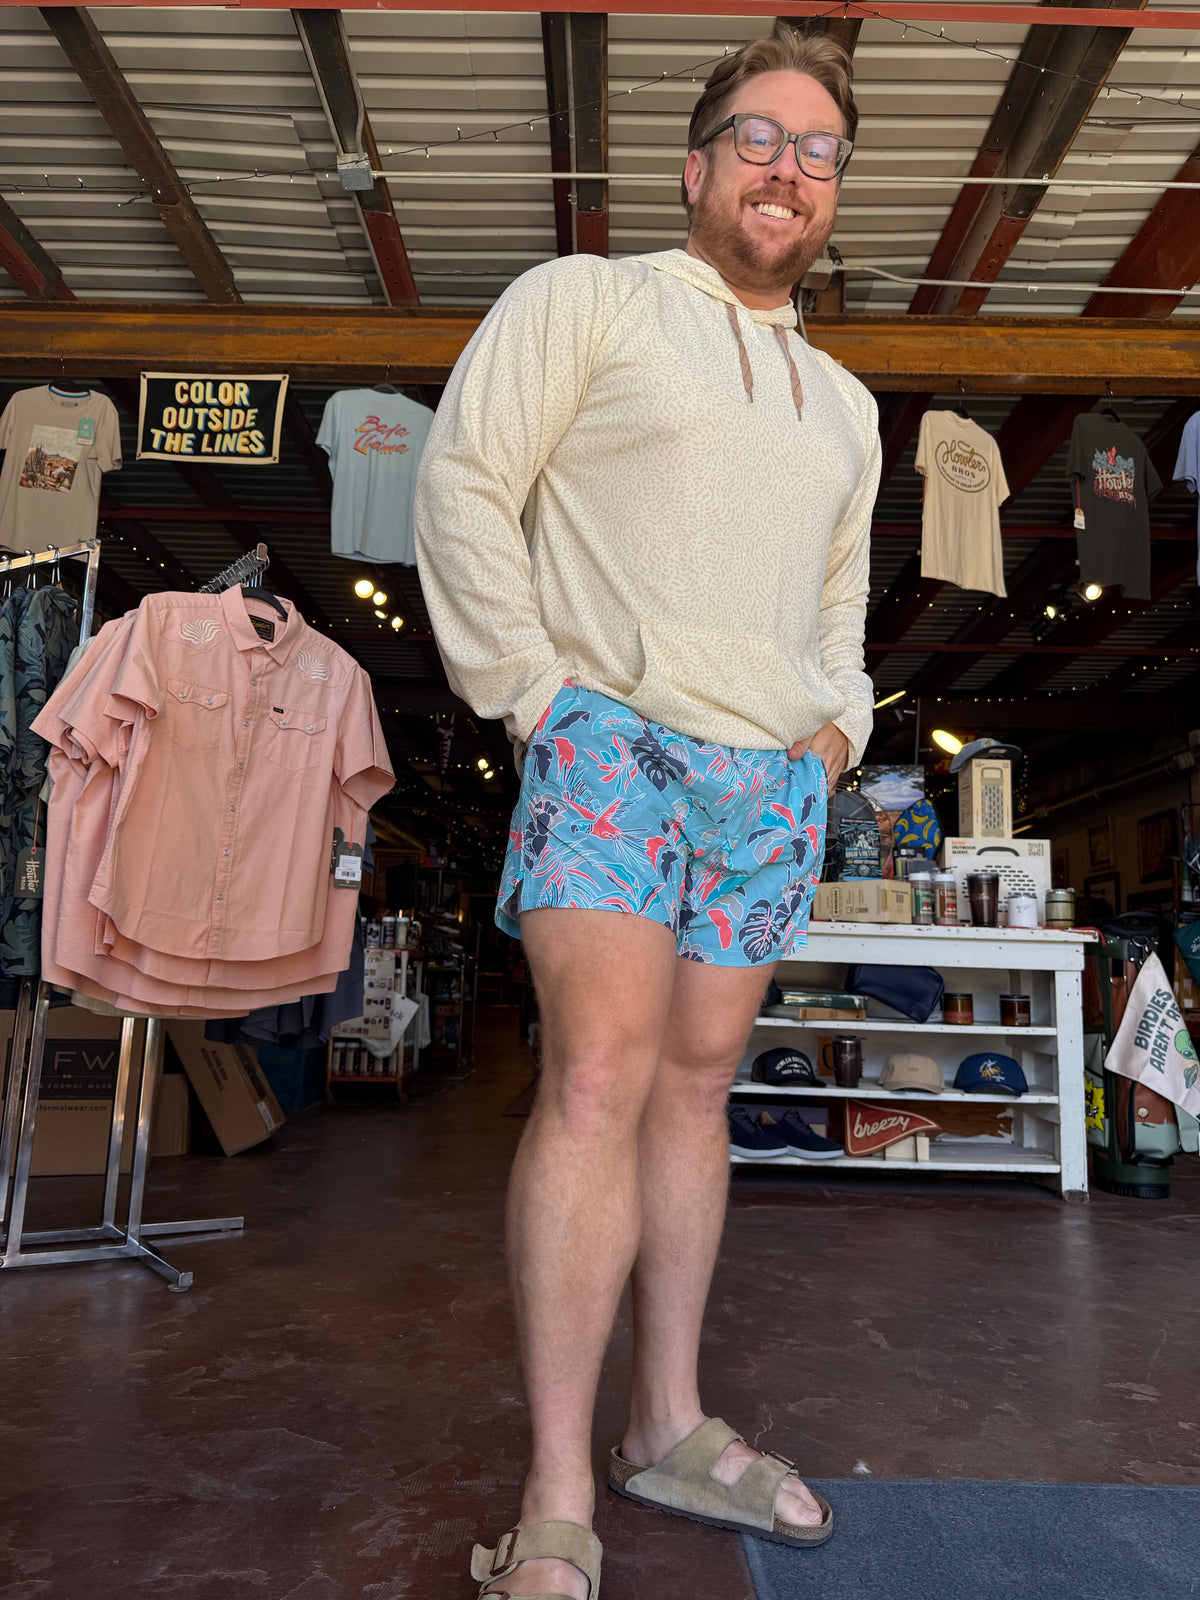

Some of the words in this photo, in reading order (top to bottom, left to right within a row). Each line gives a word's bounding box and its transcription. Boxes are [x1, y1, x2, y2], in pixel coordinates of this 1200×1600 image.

[175, 381, 250, 406] COLOR
[162, 406, 259, 432] OUTSIDE
[355, 415, 410, 444] Baja
[150, 428, 196, 454] THE
[201, 429, 266, 455] LINES
[941, 439, 987, 473] Howler
[951, 465, 976, 479] BROS
[1095, 466, 1134, 491] Howle
[25, 857, 40, 893] Howler
[1134, 988, 1173, 1051] BIRDIES
[1149, 1018, 1175, 1074] AREN'T
[1166, 1003, 1181, 1022] RE
[54, 1050, 116, 1071] FW
[37, 1104, 108, 1113] formalwear.com
[853, 1112, 910, 1139] breezy
